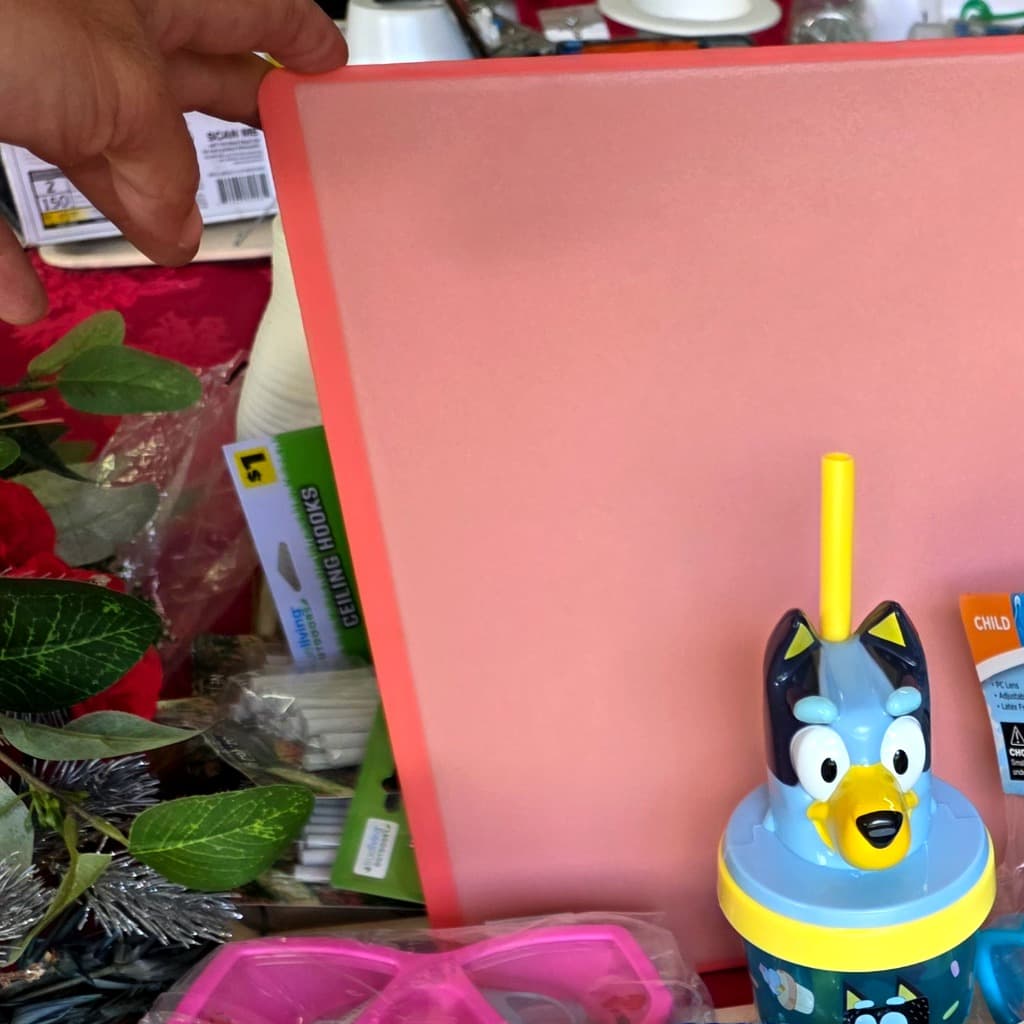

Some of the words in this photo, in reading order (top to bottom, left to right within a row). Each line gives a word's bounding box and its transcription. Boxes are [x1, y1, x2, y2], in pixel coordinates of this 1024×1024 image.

[240, 453, 267, 482] $1
[301, 486, 335, 551] HOOKS
[324, 555, 359, 628] CEILING
[974, 616, 1011, 632] CHILD
